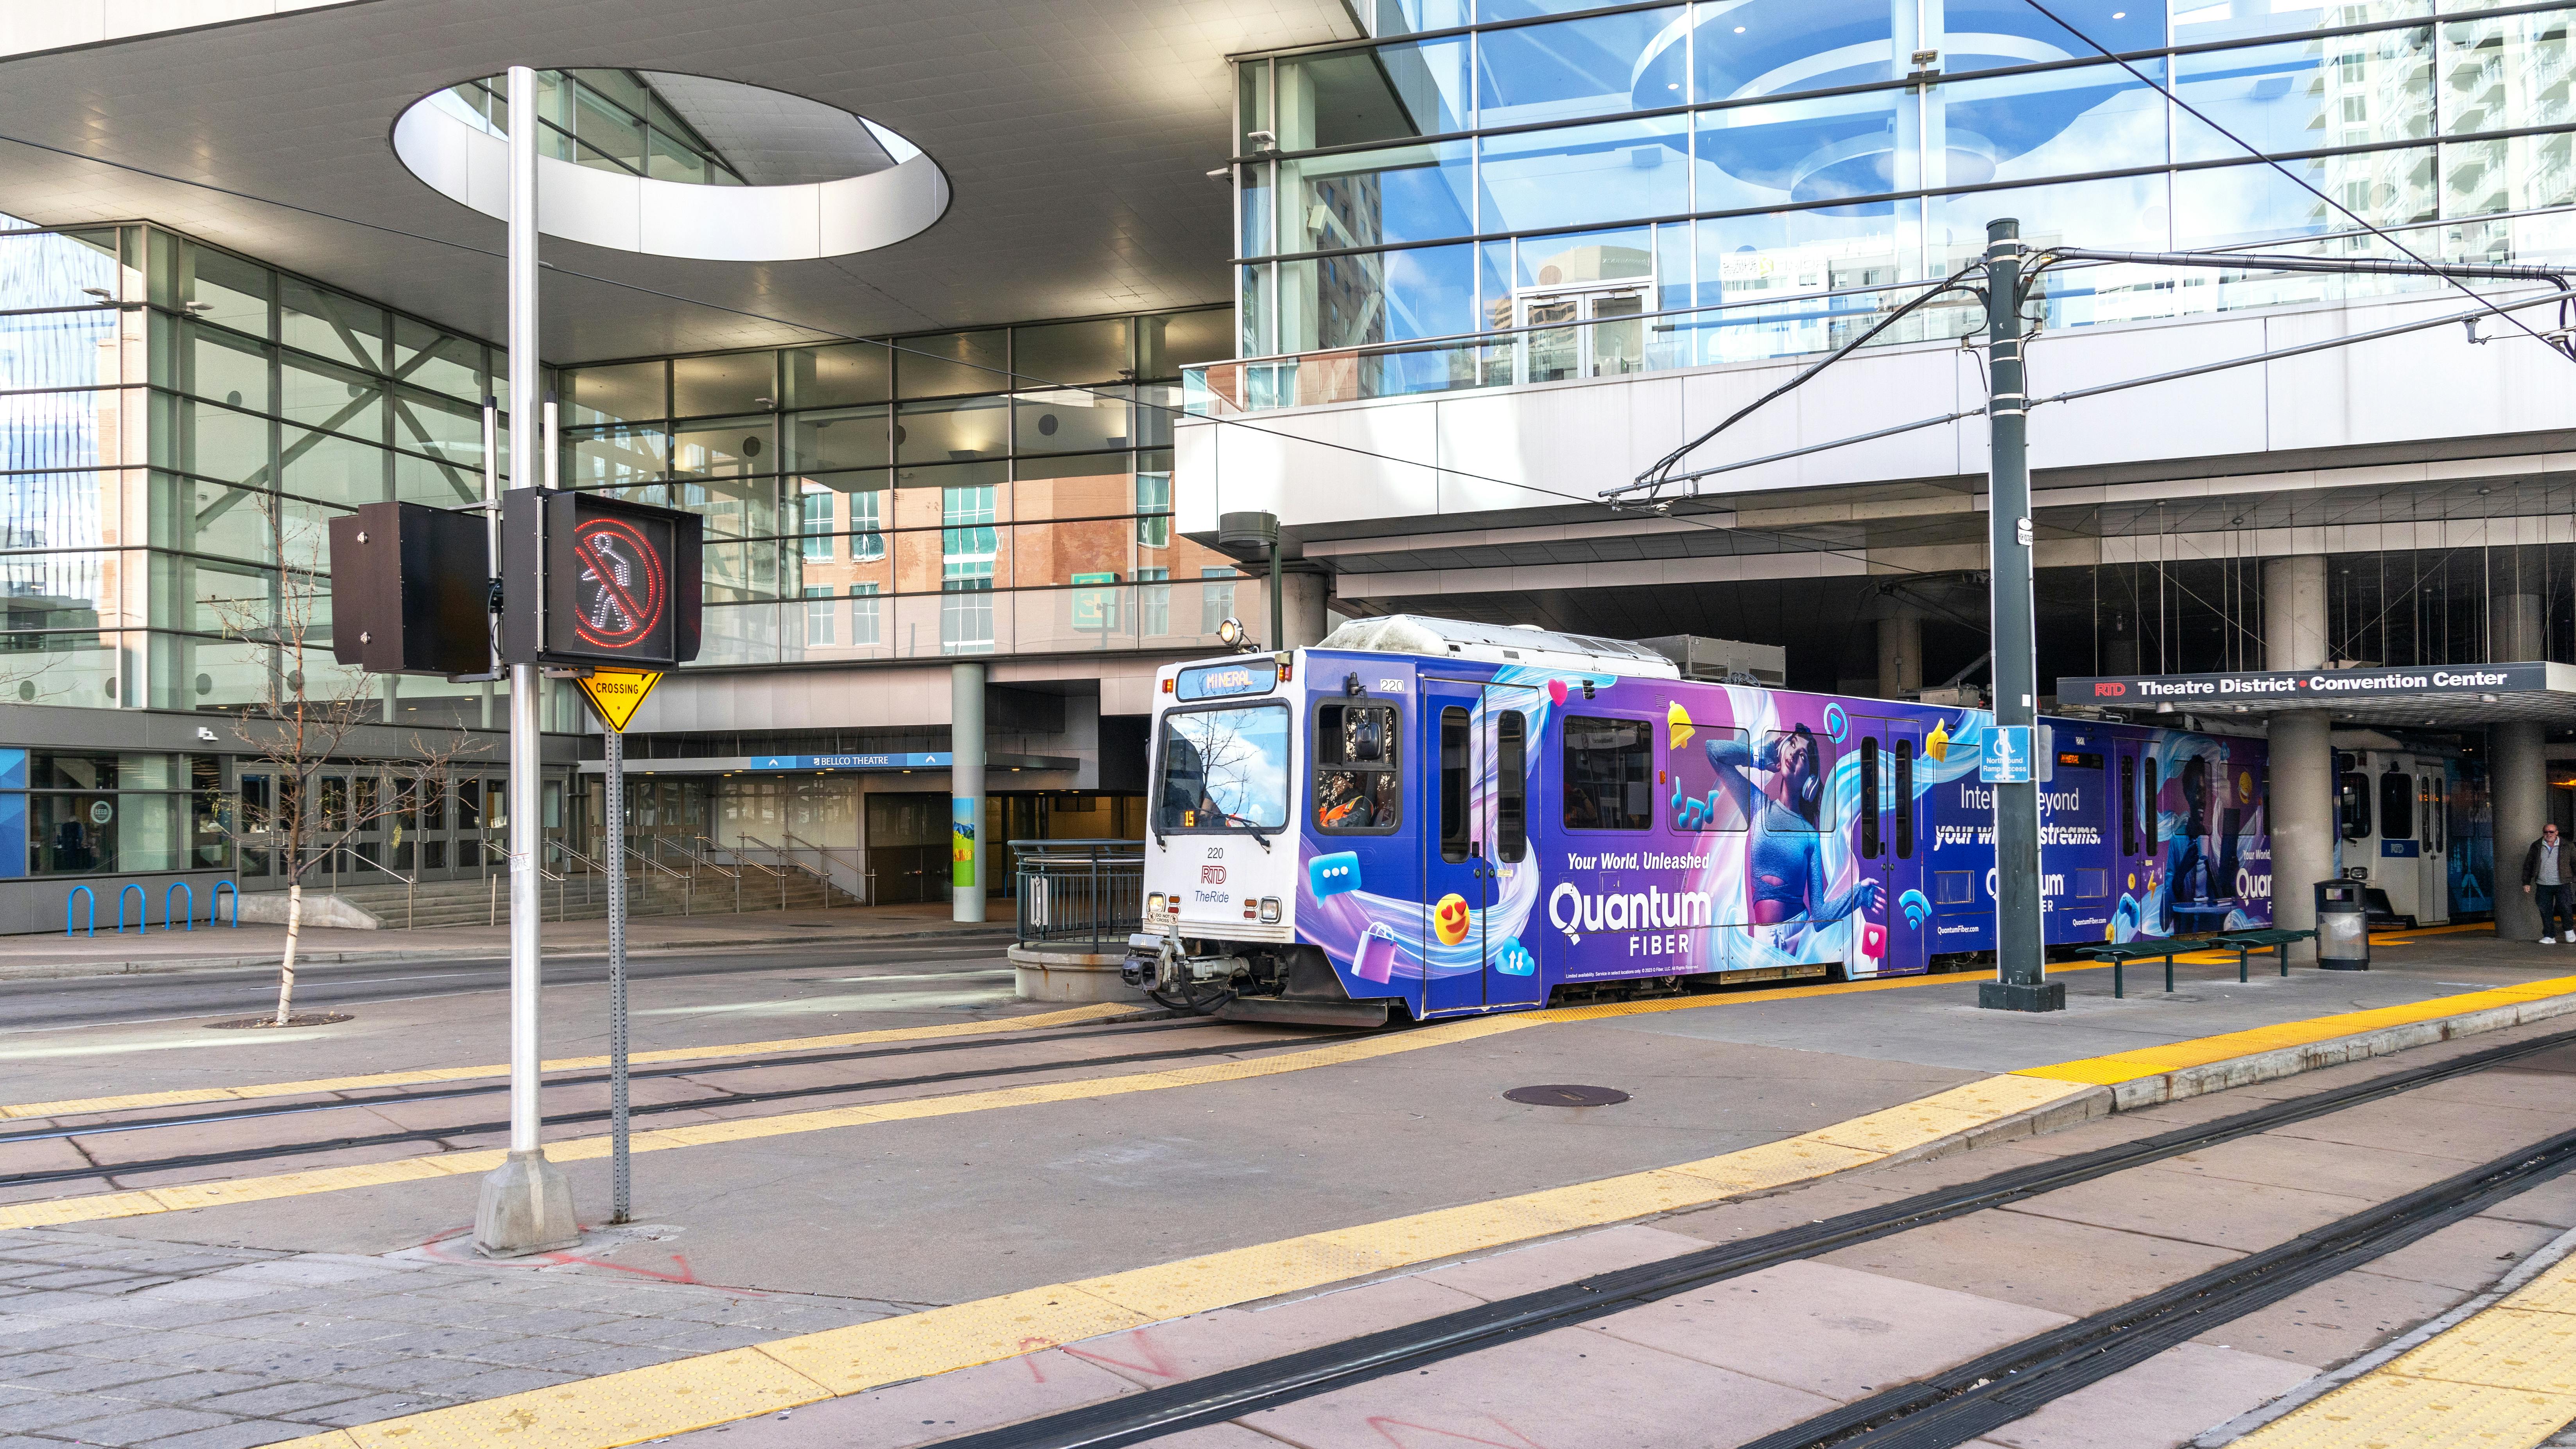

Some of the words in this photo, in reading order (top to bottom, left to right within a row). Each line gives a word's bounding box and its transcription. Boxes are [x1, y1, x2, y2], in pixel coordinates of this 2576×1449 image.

[1206, 670, 1253, 689] MINERAL
[2095, 682, 2126, 697] RTD
[2138, 681, 2215, 695] Theatre
[2220, 678, 2296, 693] District
[2310, 674, 2427, 690] Convention
[2433, 672, 2508, 687] Center
[596, 682, 639, 694] CROSSING
[1381, 680, 1403, 692] 220
[821, 757, 850, 765] BELLCO
[852, 756, 888, 765] THEATRE
[1185, 811, 1194, 826] 15
[1934, 825, 1974, 851] your
[2040, 822, 2101, 845] streams.
[1207, 847, 1223, 859] 220
[2243, 849, 2255, 860] Your
[2391, 844, 2404, 853] RTD
[1568, 853, 1597, 870] Your
[1601, 853, 1639, 871] World,
[1643, 851, 1710, 869] Unleashed
[1201, 865, 1227, 884] RTD
[1195, 891, 1229, 903] TheRide
[1549, 882, 1712, 946] Quantum
[2072, 917, 2106, 926] QuantumFiber.com
[1937, 925, 1979, 934] QuantumFiber.com
[1630, 934, 1689, 957] FIBER
